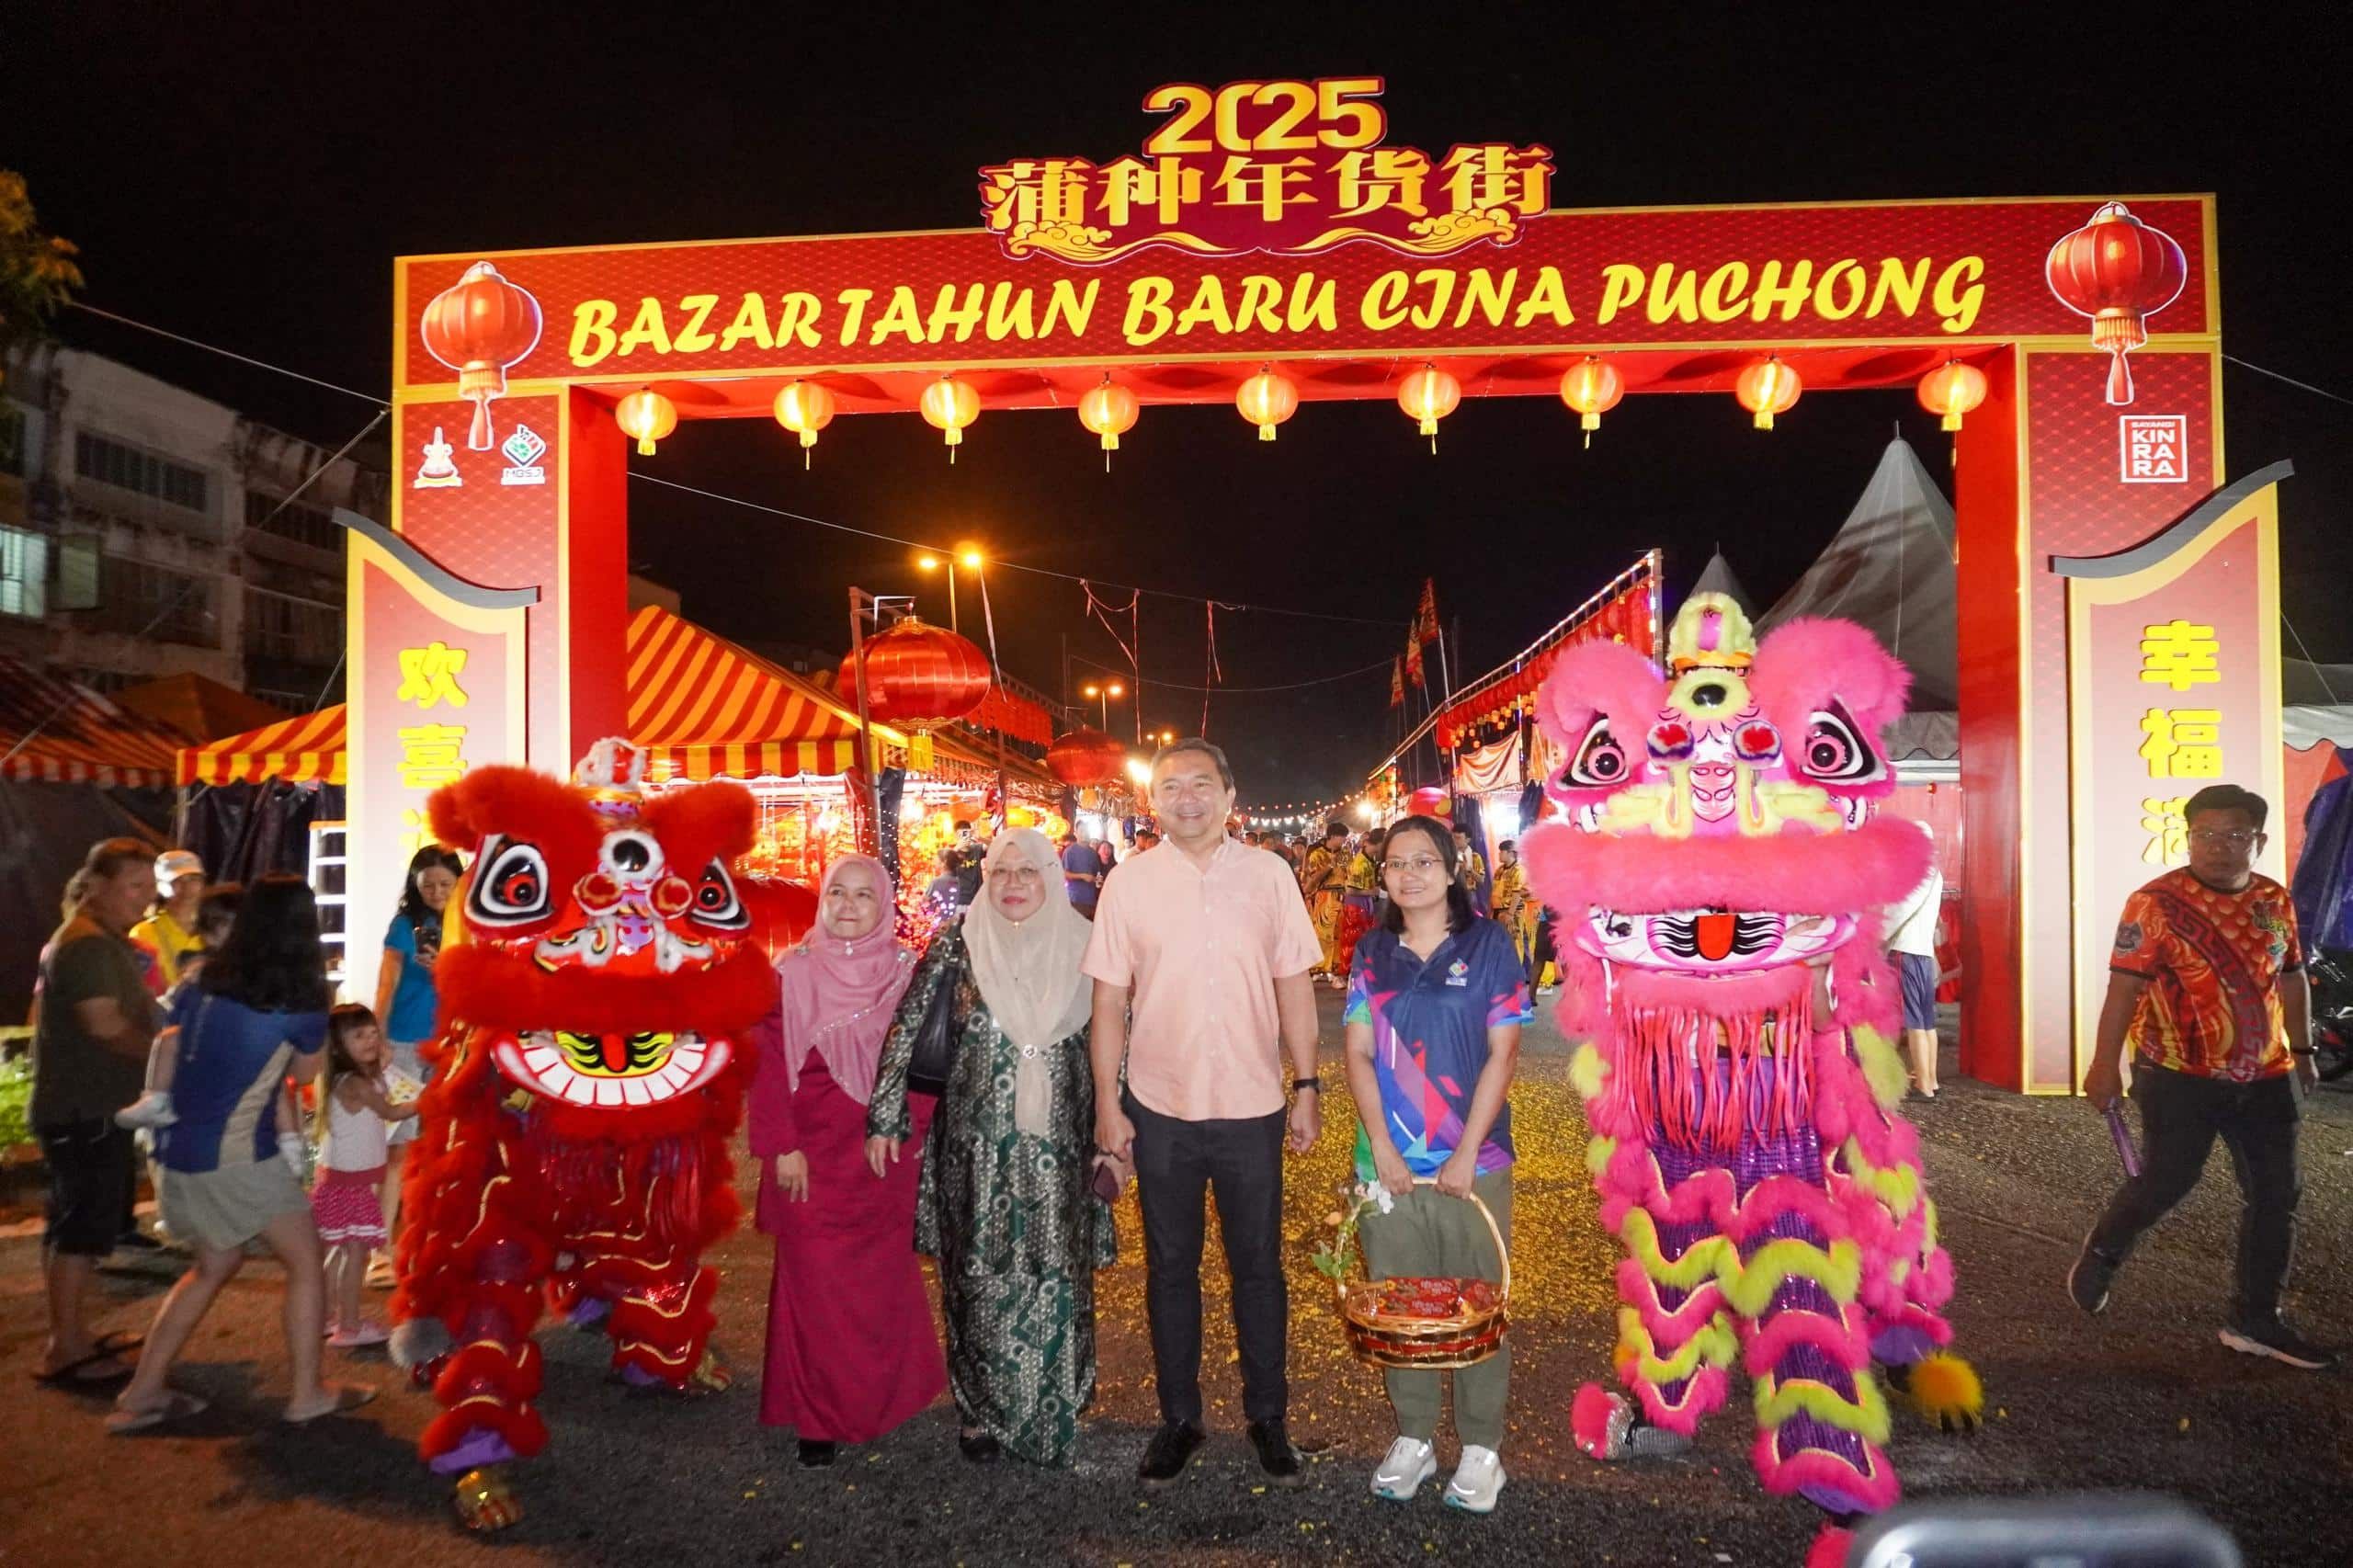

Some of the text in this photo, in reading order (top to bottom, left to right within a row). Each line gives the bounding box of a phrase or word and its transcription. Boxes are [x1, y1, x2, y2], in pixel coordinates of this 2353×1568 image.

[1149, 79, 1381, 154] 2025
[985, 147, 1552, 227] 蒲种年货街
[568, 256, 1986, 368] BAZAR TAHUN BARU CINA PUCHONG
[2132, 429, 2176, 443] KIN
[2132, 444, 2177, 460] RA
[2132, 460, 2177, 475] RA
[396, 641, 470, 869] 欢喜
